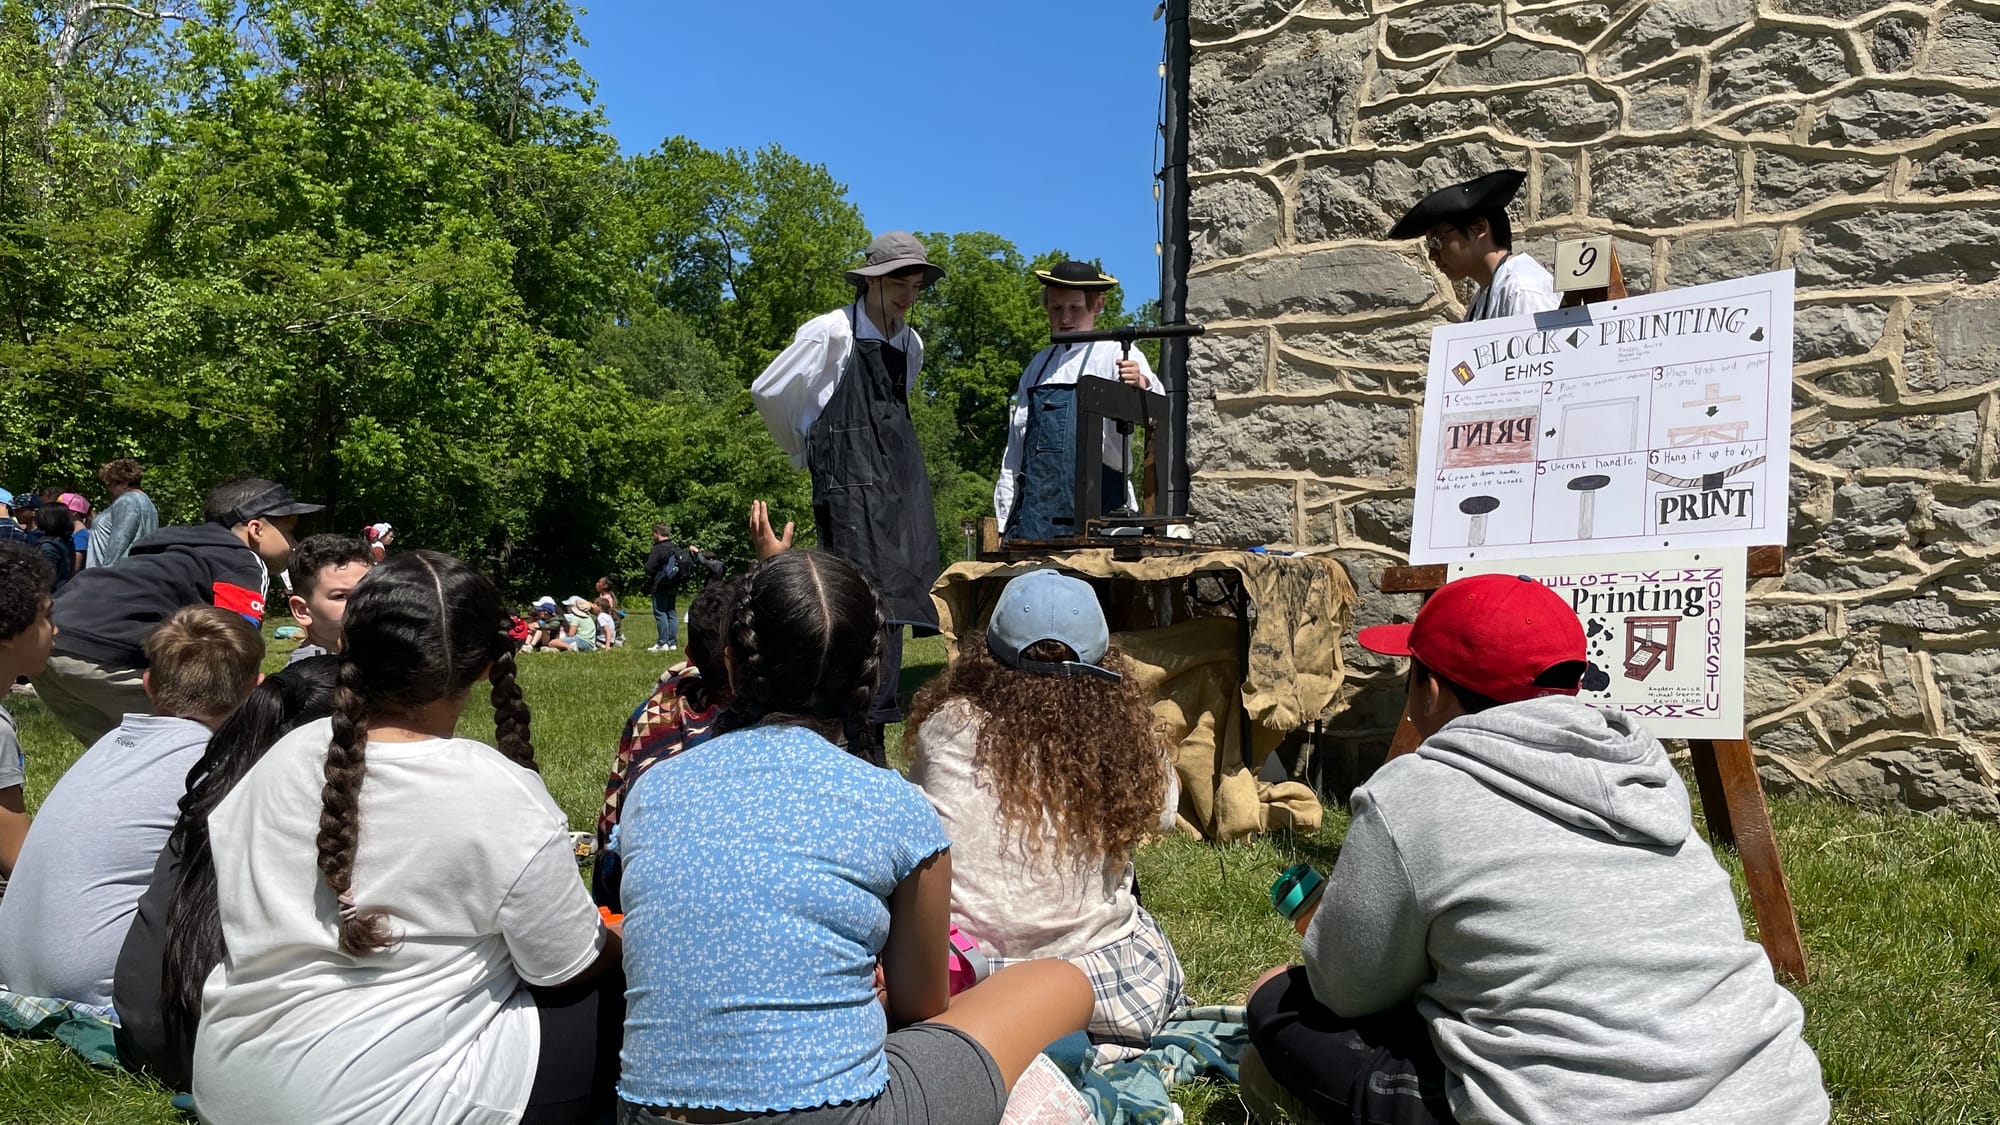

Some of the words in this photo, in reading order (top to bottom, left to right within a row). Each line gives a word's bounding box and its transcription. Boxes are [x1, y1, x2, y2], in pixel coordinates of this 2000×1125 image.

[1572, 247, 1597, 276] 9
[1472, 329, 1561, 370] BLOCK
[1599, 306, 1749, 346] PRINTING
[1505, 361, 1554, 381] EHMS
[1654, 366, 1664, 381] 3
[1721, 361, 1737, 371] and
[1746, 358, 1767, 370] paper
[1543, 380, 1553, 395] 2
[1444, 394, 1450, 408] 1
[1537, 460, 1547, 476] 5
[1550, 459, 1587, 472] Uncrank
[1595, 453, 1638, 470] handle.
[1650, 450, 1659, 465] 6
[1664, 451, 1686, 465] Hang
[1692, 450, 1702, 460] it
[1709, 450, 1719, 460] up
[1725, 448, 1735, 457] to
[1740, 444, 1759, 458] dry!
[1437, 469, 1446, 483] 4
[1448, 473, 1475, 482] Crank
[1659, 488, 1753, 525] PRINT
[1571, 583, 1706, 617] Printing
